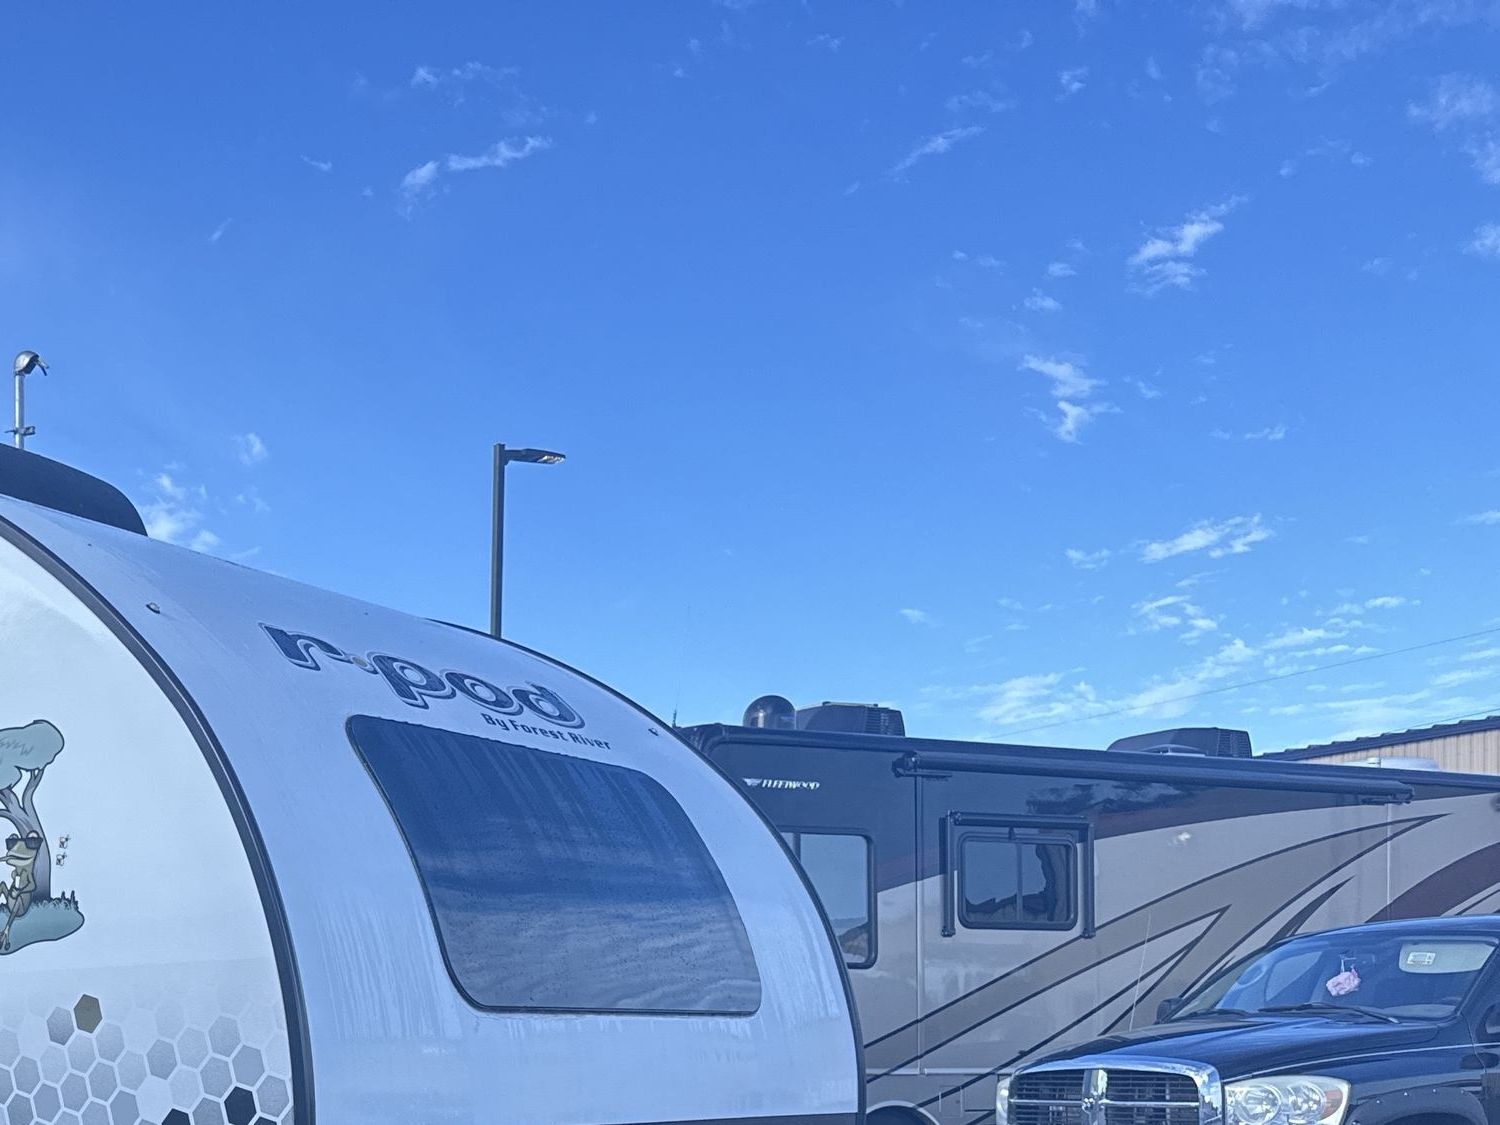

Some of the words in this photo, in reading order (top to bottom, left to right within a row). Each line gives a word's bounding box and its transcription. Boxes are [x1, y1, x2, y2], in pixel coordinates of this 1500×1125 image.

[480, 712, 510, 732] By
[508, 719, 569, 742] Forest
[567, 732, 611, 751] River
